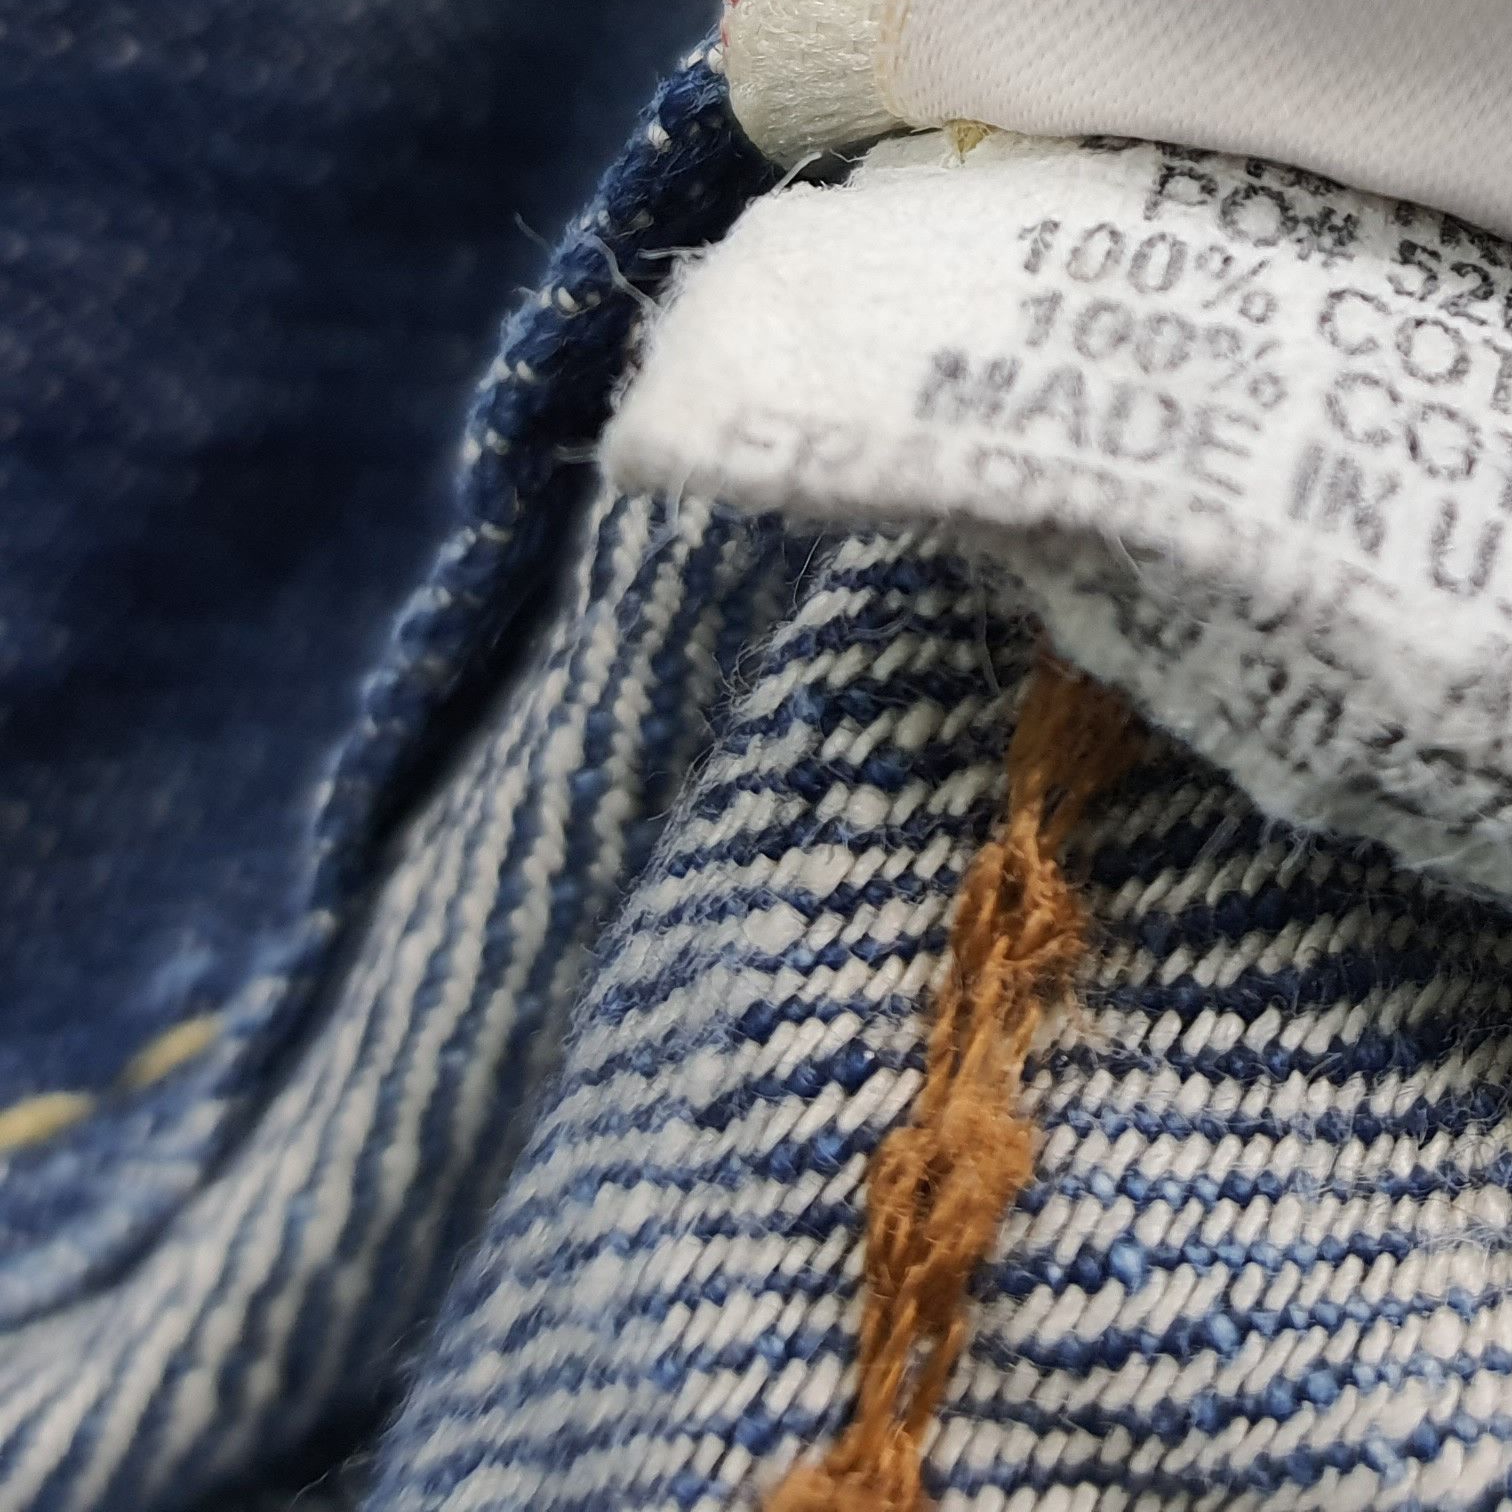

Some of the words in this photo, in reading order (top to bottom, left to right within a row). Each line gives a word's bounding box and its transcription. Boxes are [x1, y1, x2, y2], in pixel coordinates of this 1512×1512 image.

[1017, 219, 1279, 323] 100%
[1021, 290, 1288, 408] 100%
[915, 347, 1264, 495] MADE
[1289, 438, 1402, 556] IN
